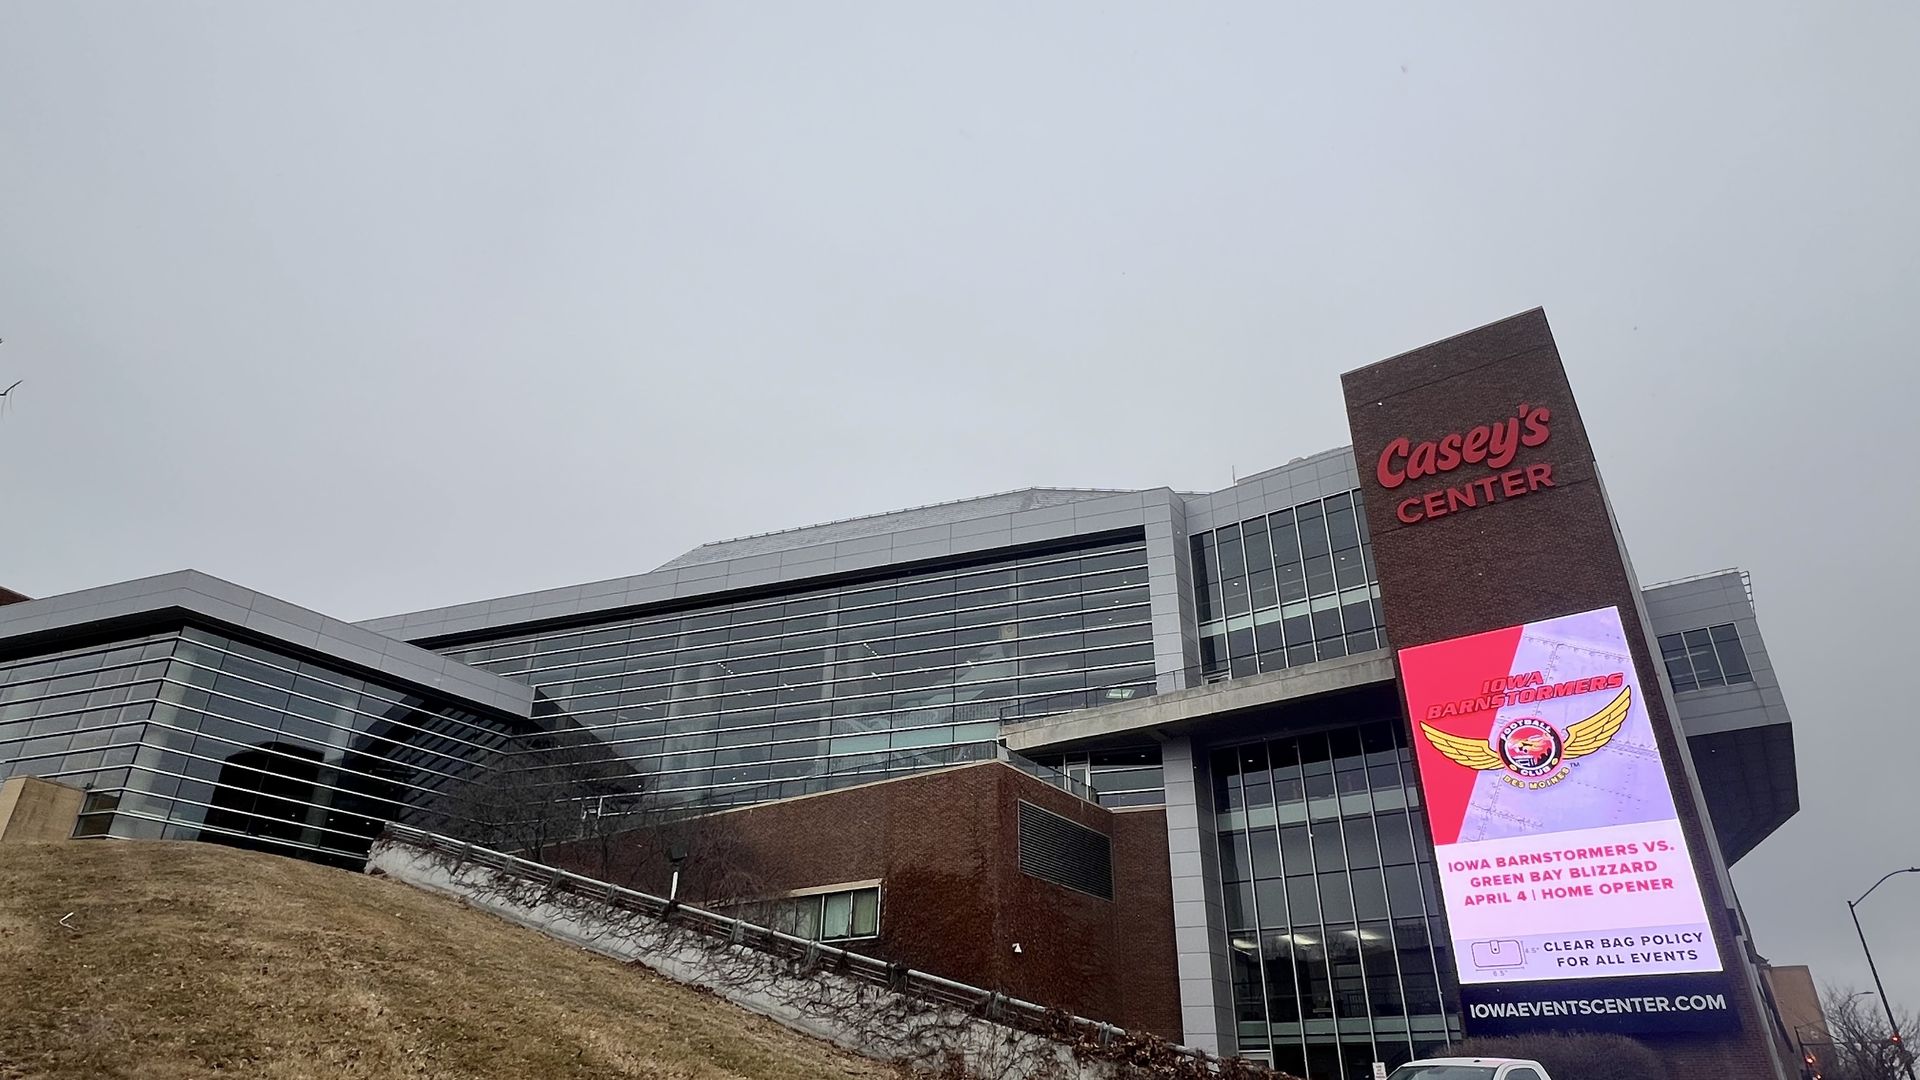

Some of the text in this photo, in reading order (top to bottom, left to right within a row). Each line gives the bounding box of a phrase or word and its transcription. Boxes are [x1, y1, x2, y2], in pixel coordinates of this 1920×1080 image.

[1377, 404, 1551, 489] Casey's
[1396, 463, 1555, 524] CENTER
[1481, 671, 1544, 694] IOWA
[1427, 673, 1624, 720] BARNSTORMERS
[1500, 719, 1552, 741] FOOTBALL
[1503, 767, 1571, 790] DES MOINES
[1520, 765, 1552, 777] CLUB
[1448, 840, 1675, 873] IOWA BARNSTORMERS VS.
[1470, 860, 1658, 888] GREEN BAY BLIZZARD
[1464, 892, 1512, 906] APRIL
[1517, 890, 1528, 902] 4
[1541, 885, 1594, 900] HOME
[1599, 878, 1674, 896] OPENER
[1543, 932, 1703, 952] CLEAR BAG POLICY
[1557, 949, 1698, 967] FOR ALL EVENTS
[1469, 994, 1727, 1019] IOWAEVENTSCENTER.COM
